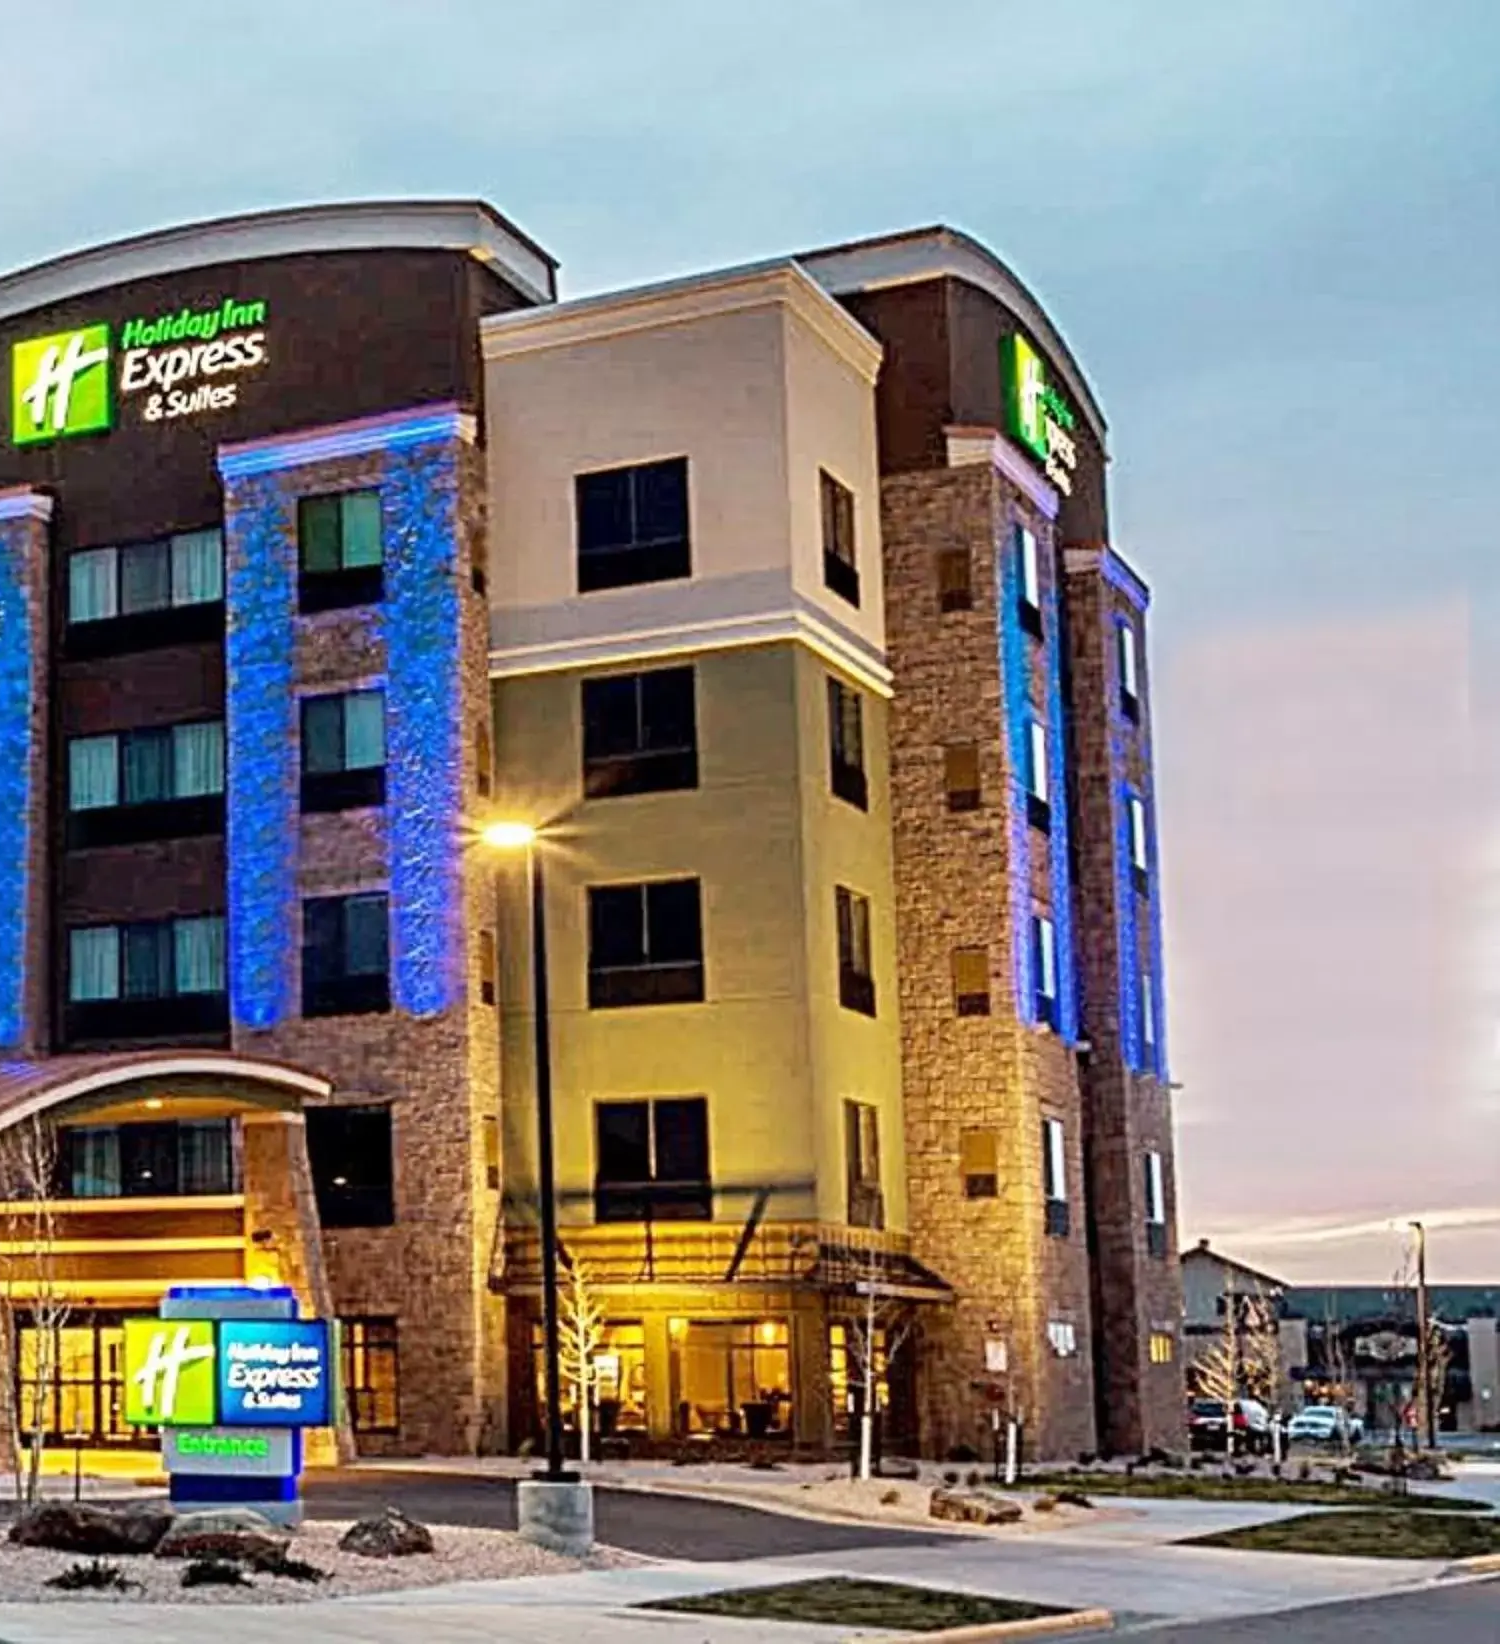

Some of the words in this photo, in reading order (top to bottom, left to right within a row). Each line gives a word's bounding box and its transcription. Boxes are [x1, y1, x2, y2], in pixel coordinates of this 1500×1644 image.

[121, 308, 220, 349] Holiday
[221, 299, 265, 328] Inn
[121, 332, 265, 392] Express
[143, 393, 163, 422] &
[165, 383, 238, 418] Suites
[227, 1342, 289, 1365] Holiday
[291, 1342, 319, 1361] Inn
[227, 1362, 321, 1393] Express
[176, 1432, 268, 1456] Entrance
